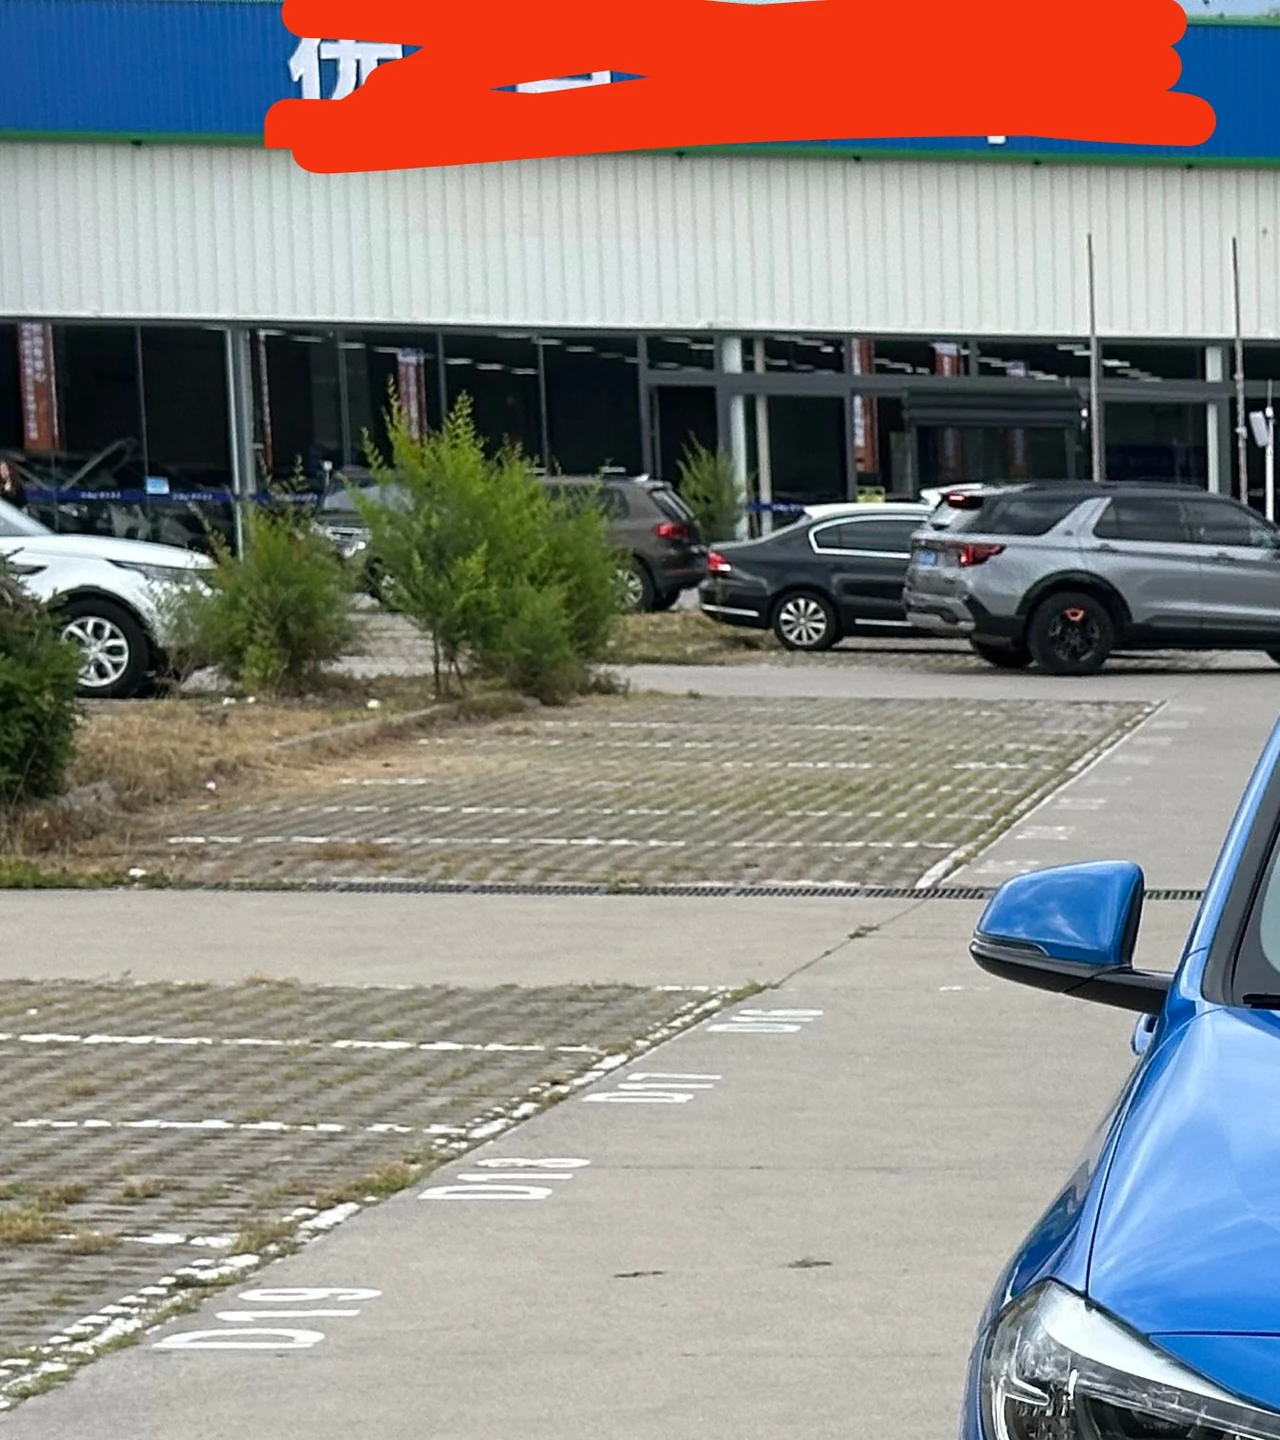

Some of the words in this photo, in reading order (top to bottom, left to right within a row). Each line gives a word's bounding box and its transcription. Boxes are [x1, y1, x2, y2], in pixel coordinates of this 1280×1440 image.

[582, 1073, 722, 1103] D17
[418, 1158, 590, 1200] D18
[152, 1287, 382, 1349] D19
